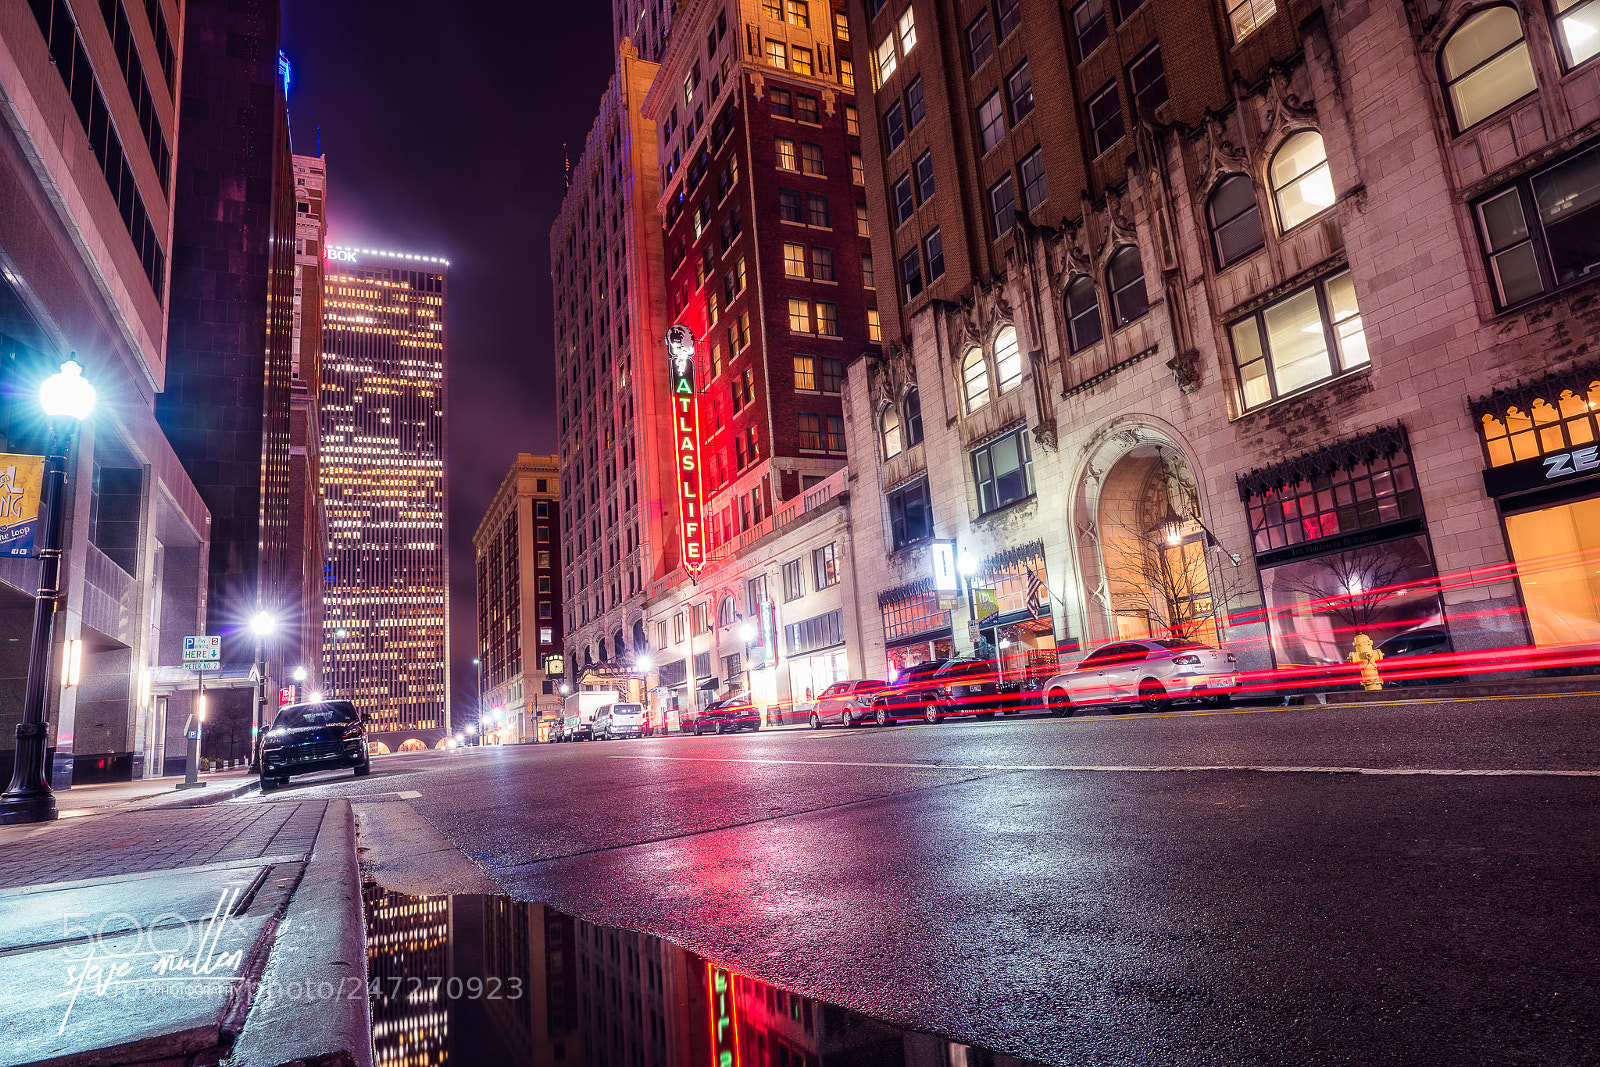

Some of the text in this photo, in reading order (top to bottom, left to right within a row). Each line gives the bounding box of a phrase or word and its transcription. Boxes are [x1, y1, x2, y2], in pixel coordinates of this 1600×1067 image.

[328, 249, 357, 263] BOK
[676, 378, 700, 558] ATLAS LIFE
[185, 650, 206, 658] HERE
